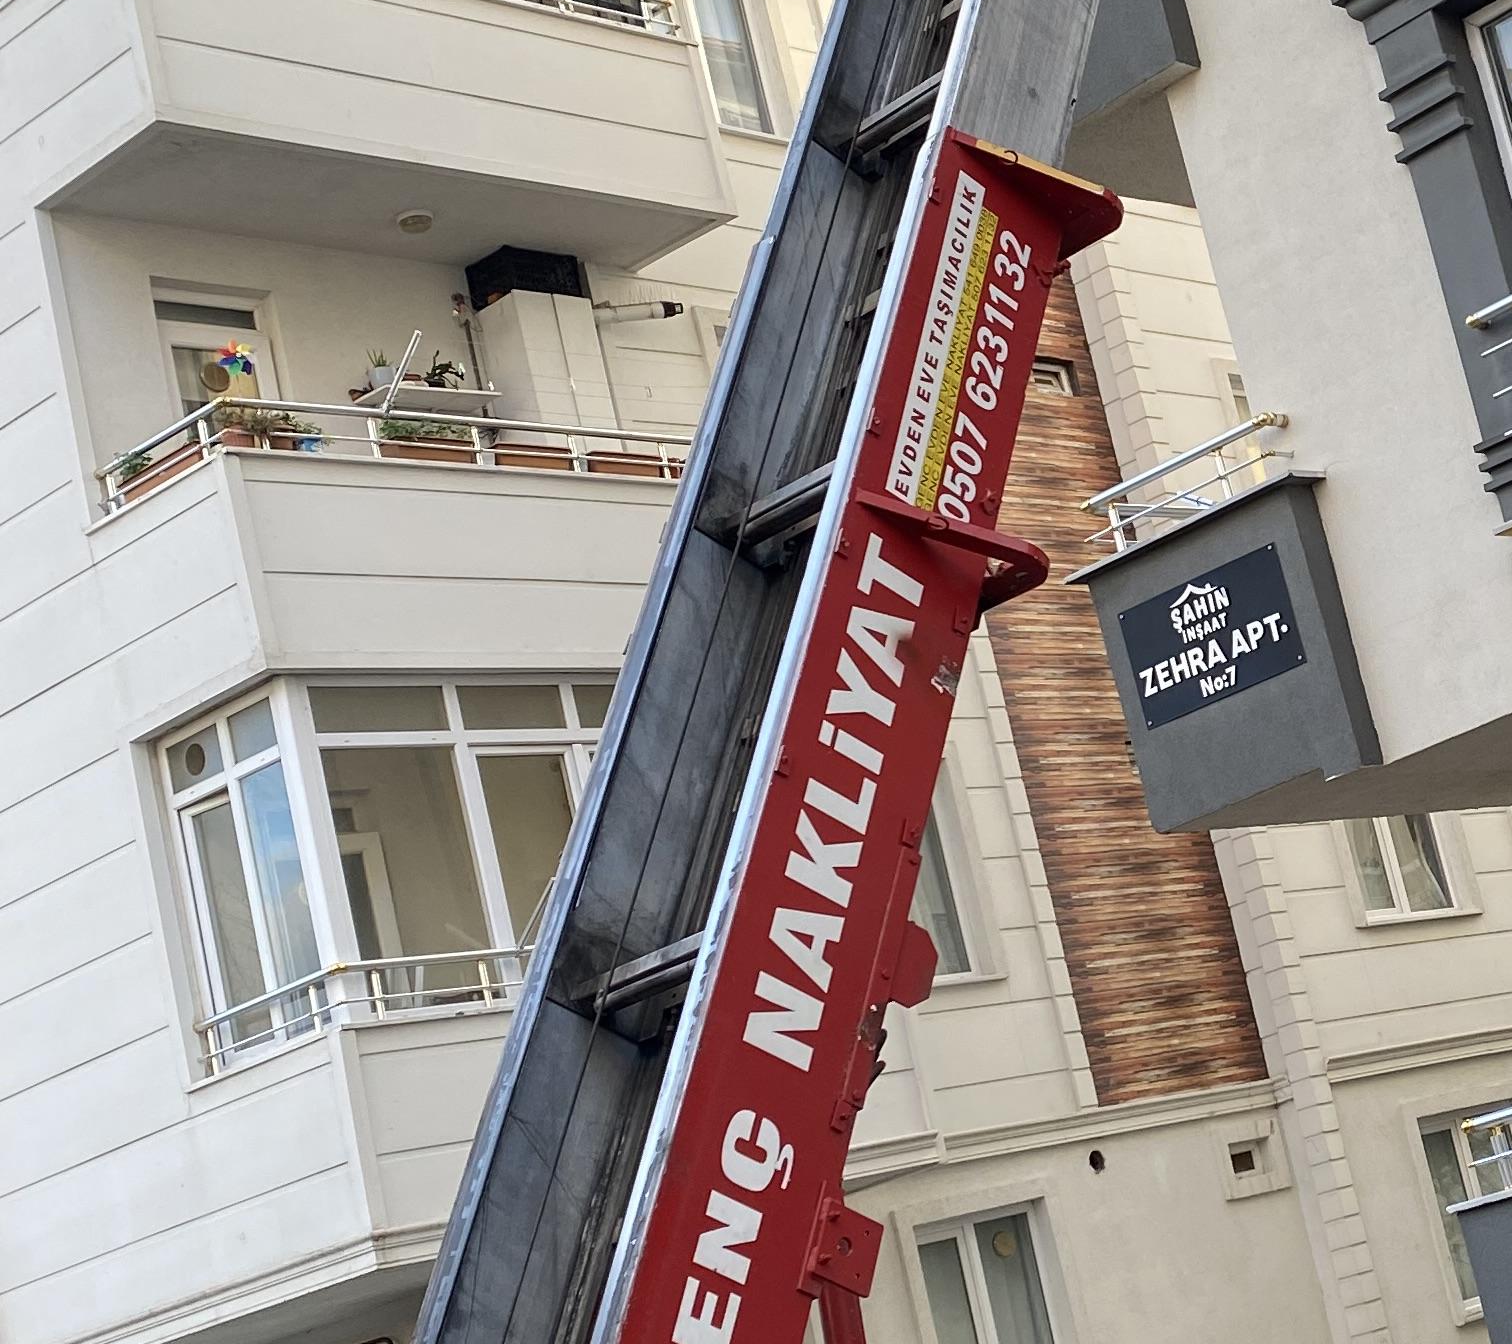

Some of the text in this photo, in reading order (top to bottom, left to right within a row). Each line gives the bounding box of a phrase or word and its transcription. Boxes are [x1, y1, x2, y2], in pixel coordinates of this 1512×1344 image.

[894, 186, 977, 498] EVDEN EVE TAŞIMACILIK
[938, 230, 1032, 523] 0507 6231132
[1139, 612, 1289, 698] ZEHRA APT.
[1200, 665, 1237, 698] No:7
